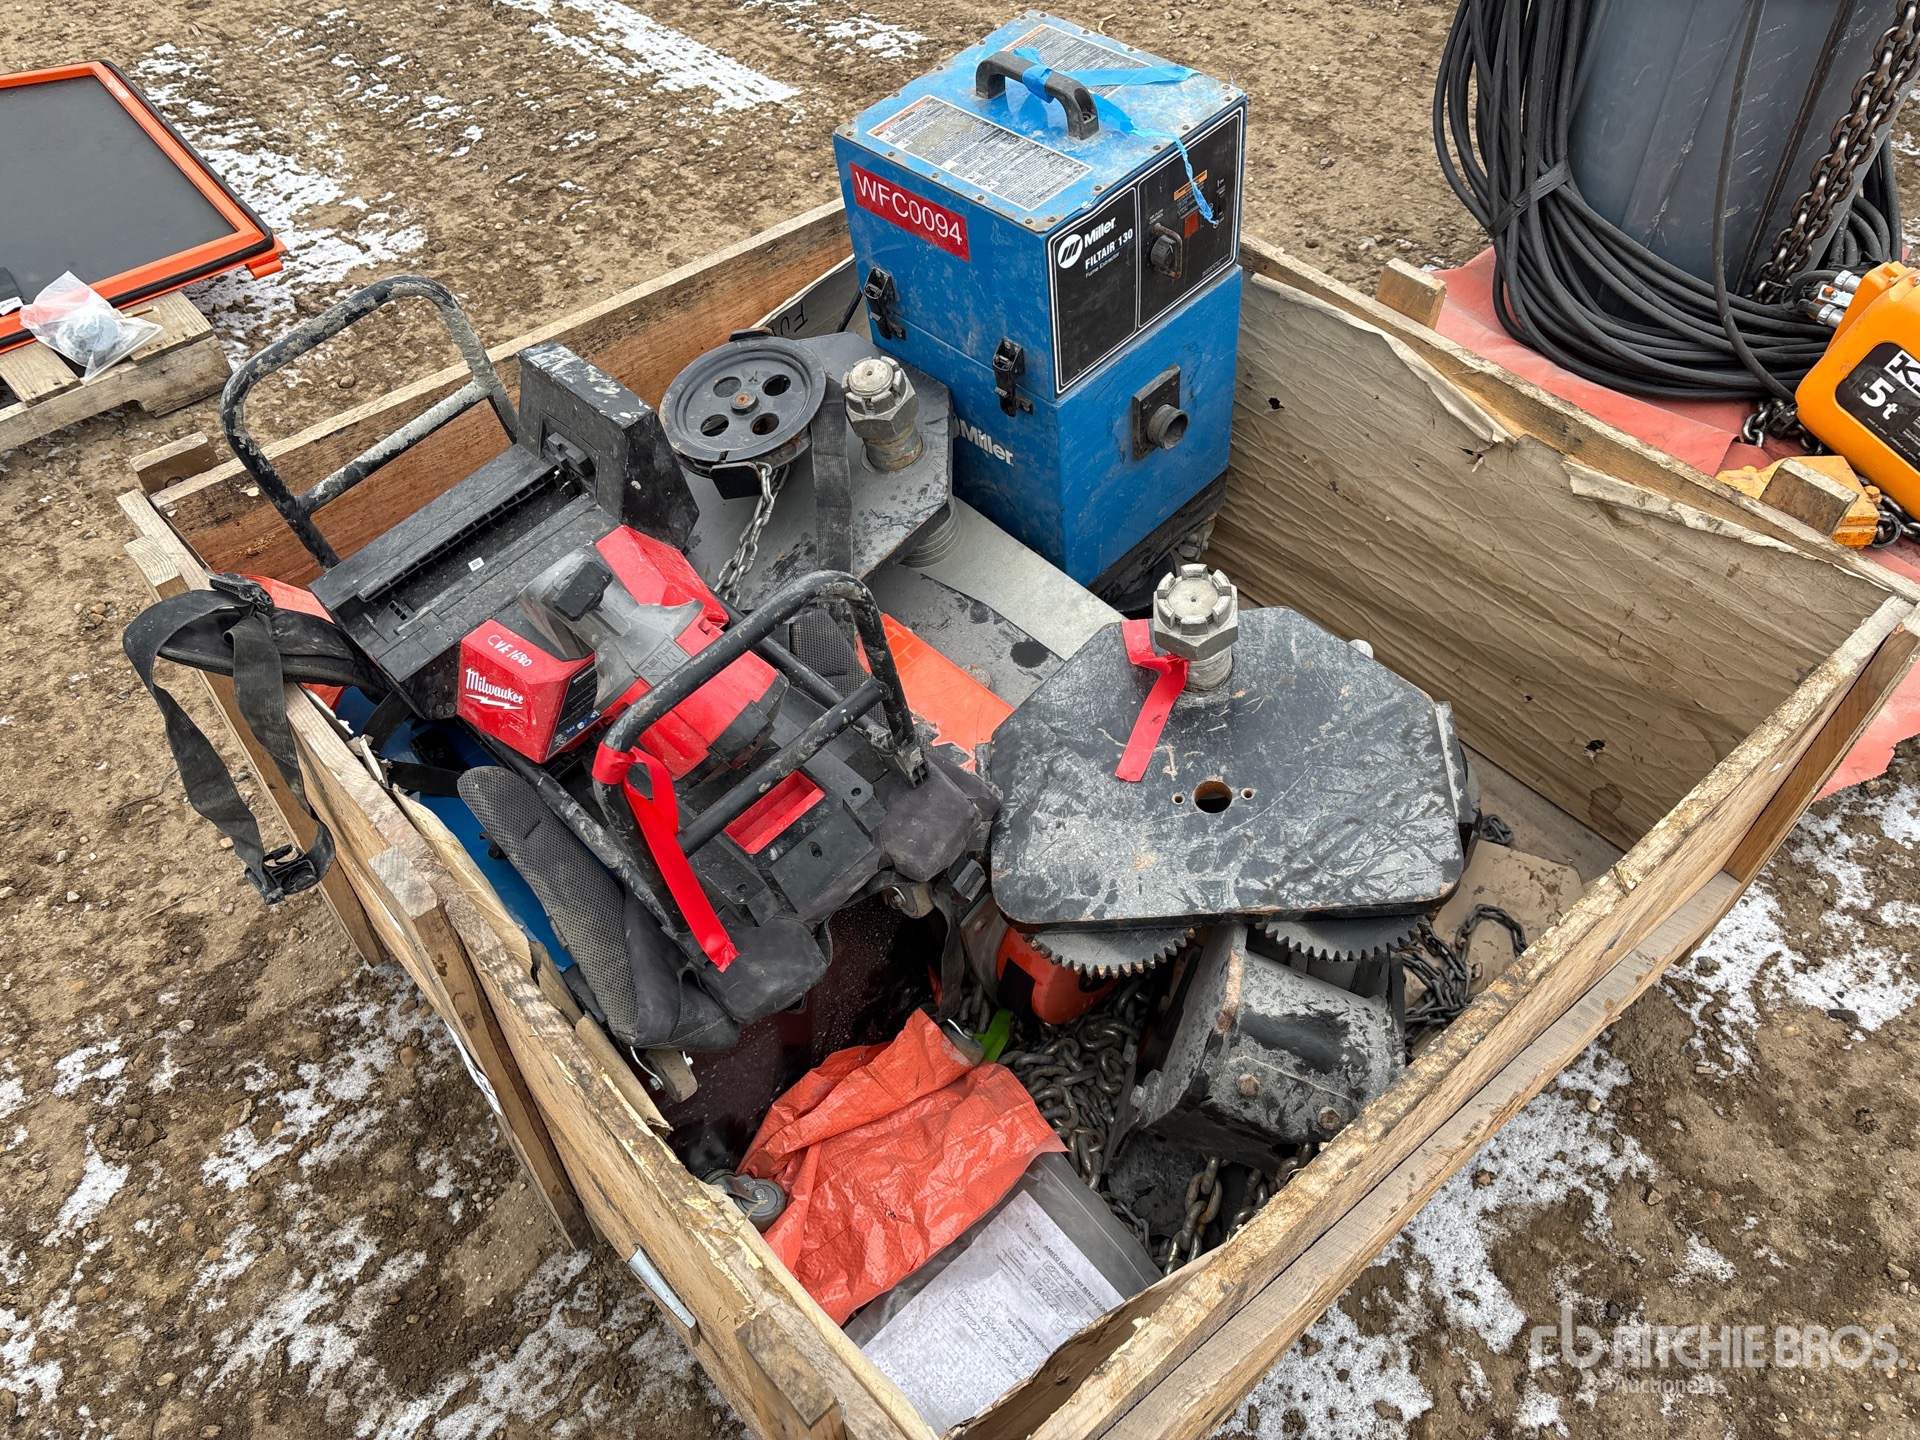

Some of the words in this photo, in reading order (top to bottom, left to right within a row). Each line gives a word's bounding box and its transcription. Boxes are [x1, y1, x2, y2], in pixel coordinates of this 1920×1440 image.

[856, 172, 962, 245] WFC0094
[1084, 217, 1116, 248] Miller
[1086, 241, 1116, 270] FILTAIR
[1118, 228, 1133, 246] 130
[1086, 267, 1099, 278] Fume
[1100, 252, 1120, 268] Extractor
[1860, 377, 1896, 407] 5
[1882, 403, 1898, 420] t
[960, 419, 1012, 465] Miller
[466, 668, 524, 704] Milwaukee
[1033, 1335, 1052, 1354] INVENTOR
